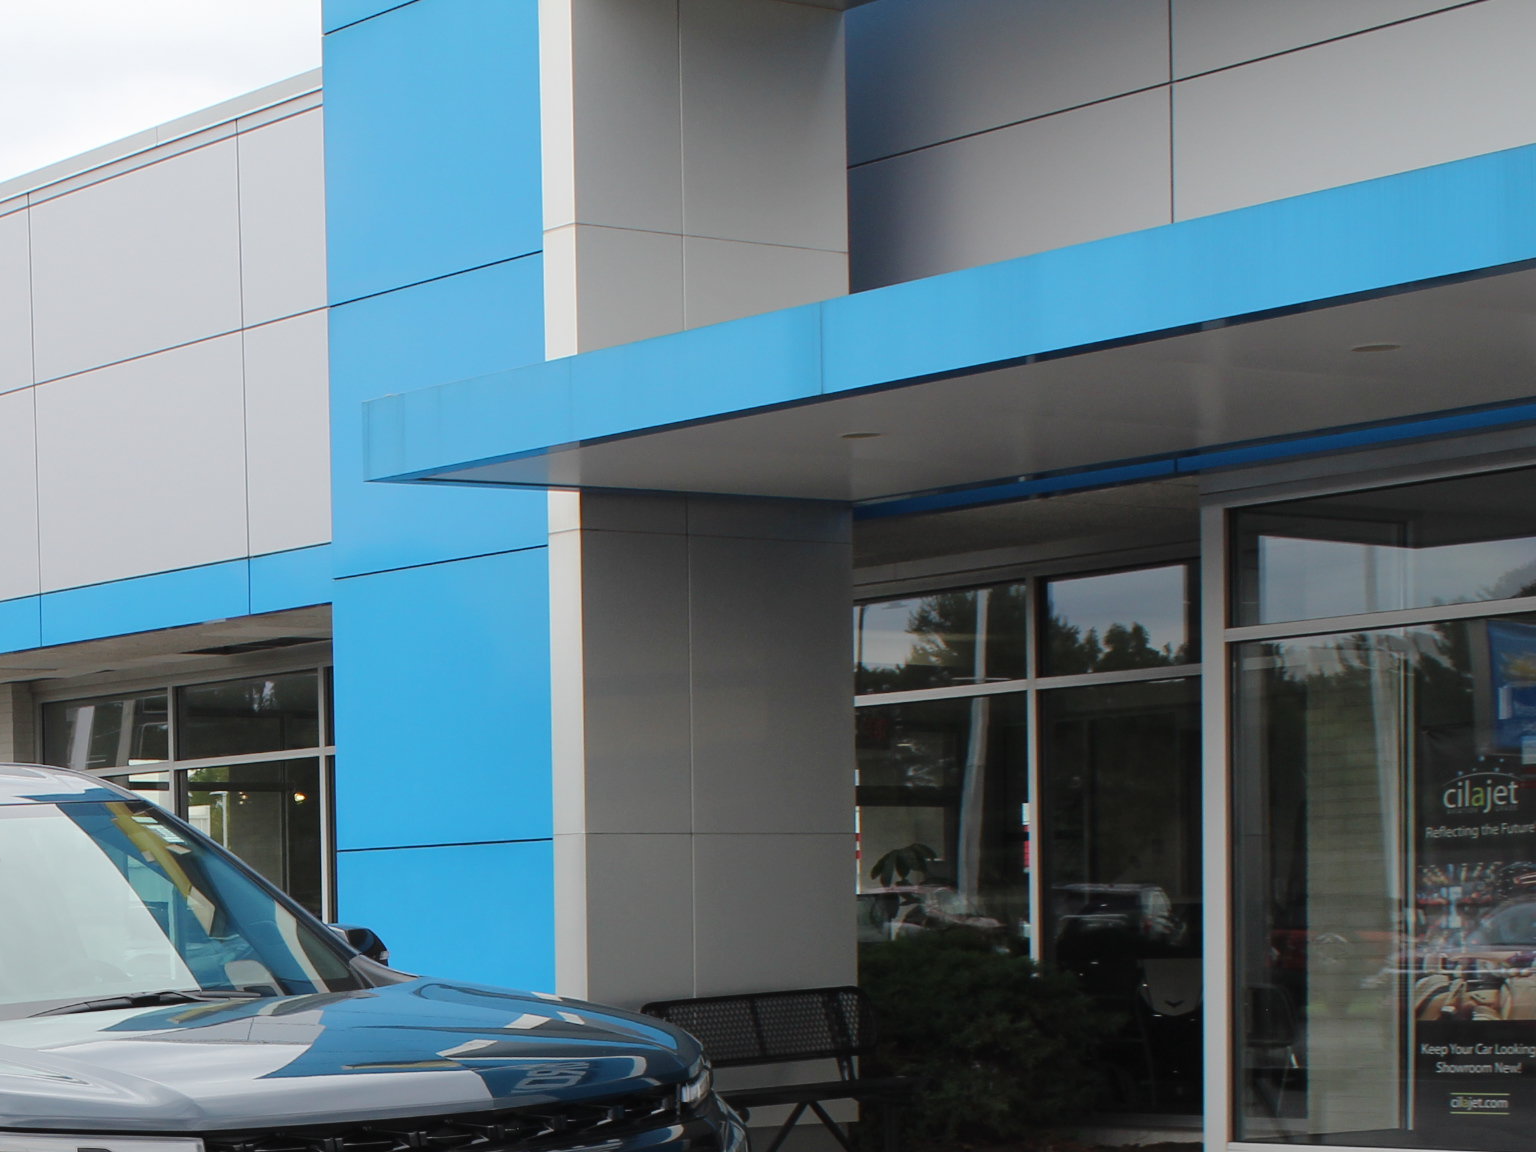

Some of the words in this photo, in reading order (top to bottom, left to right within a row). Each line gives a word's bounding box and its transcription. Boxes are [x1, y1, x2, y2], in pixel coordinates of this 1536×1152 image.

[1443, 779, 1520, 813] cilajet
[1425, 825, 1479, 839] Reflecting
[1481, 823, 1499, 836] the
[1500, 822, 1536, 835] Future
[1421, 1043, 1449, 1057] Keep
[1449, 1043, 1474, 1055] Your
[1475, 1043, 1493, 1055] Car
[1495, 1043, 1536, 1058] Looking
[1436, 1061, 1493, 1073] Showroom
[1494, 1062, 1523, 1073] New!
[1450, 1096, 1509, 1110] cilajet.com
